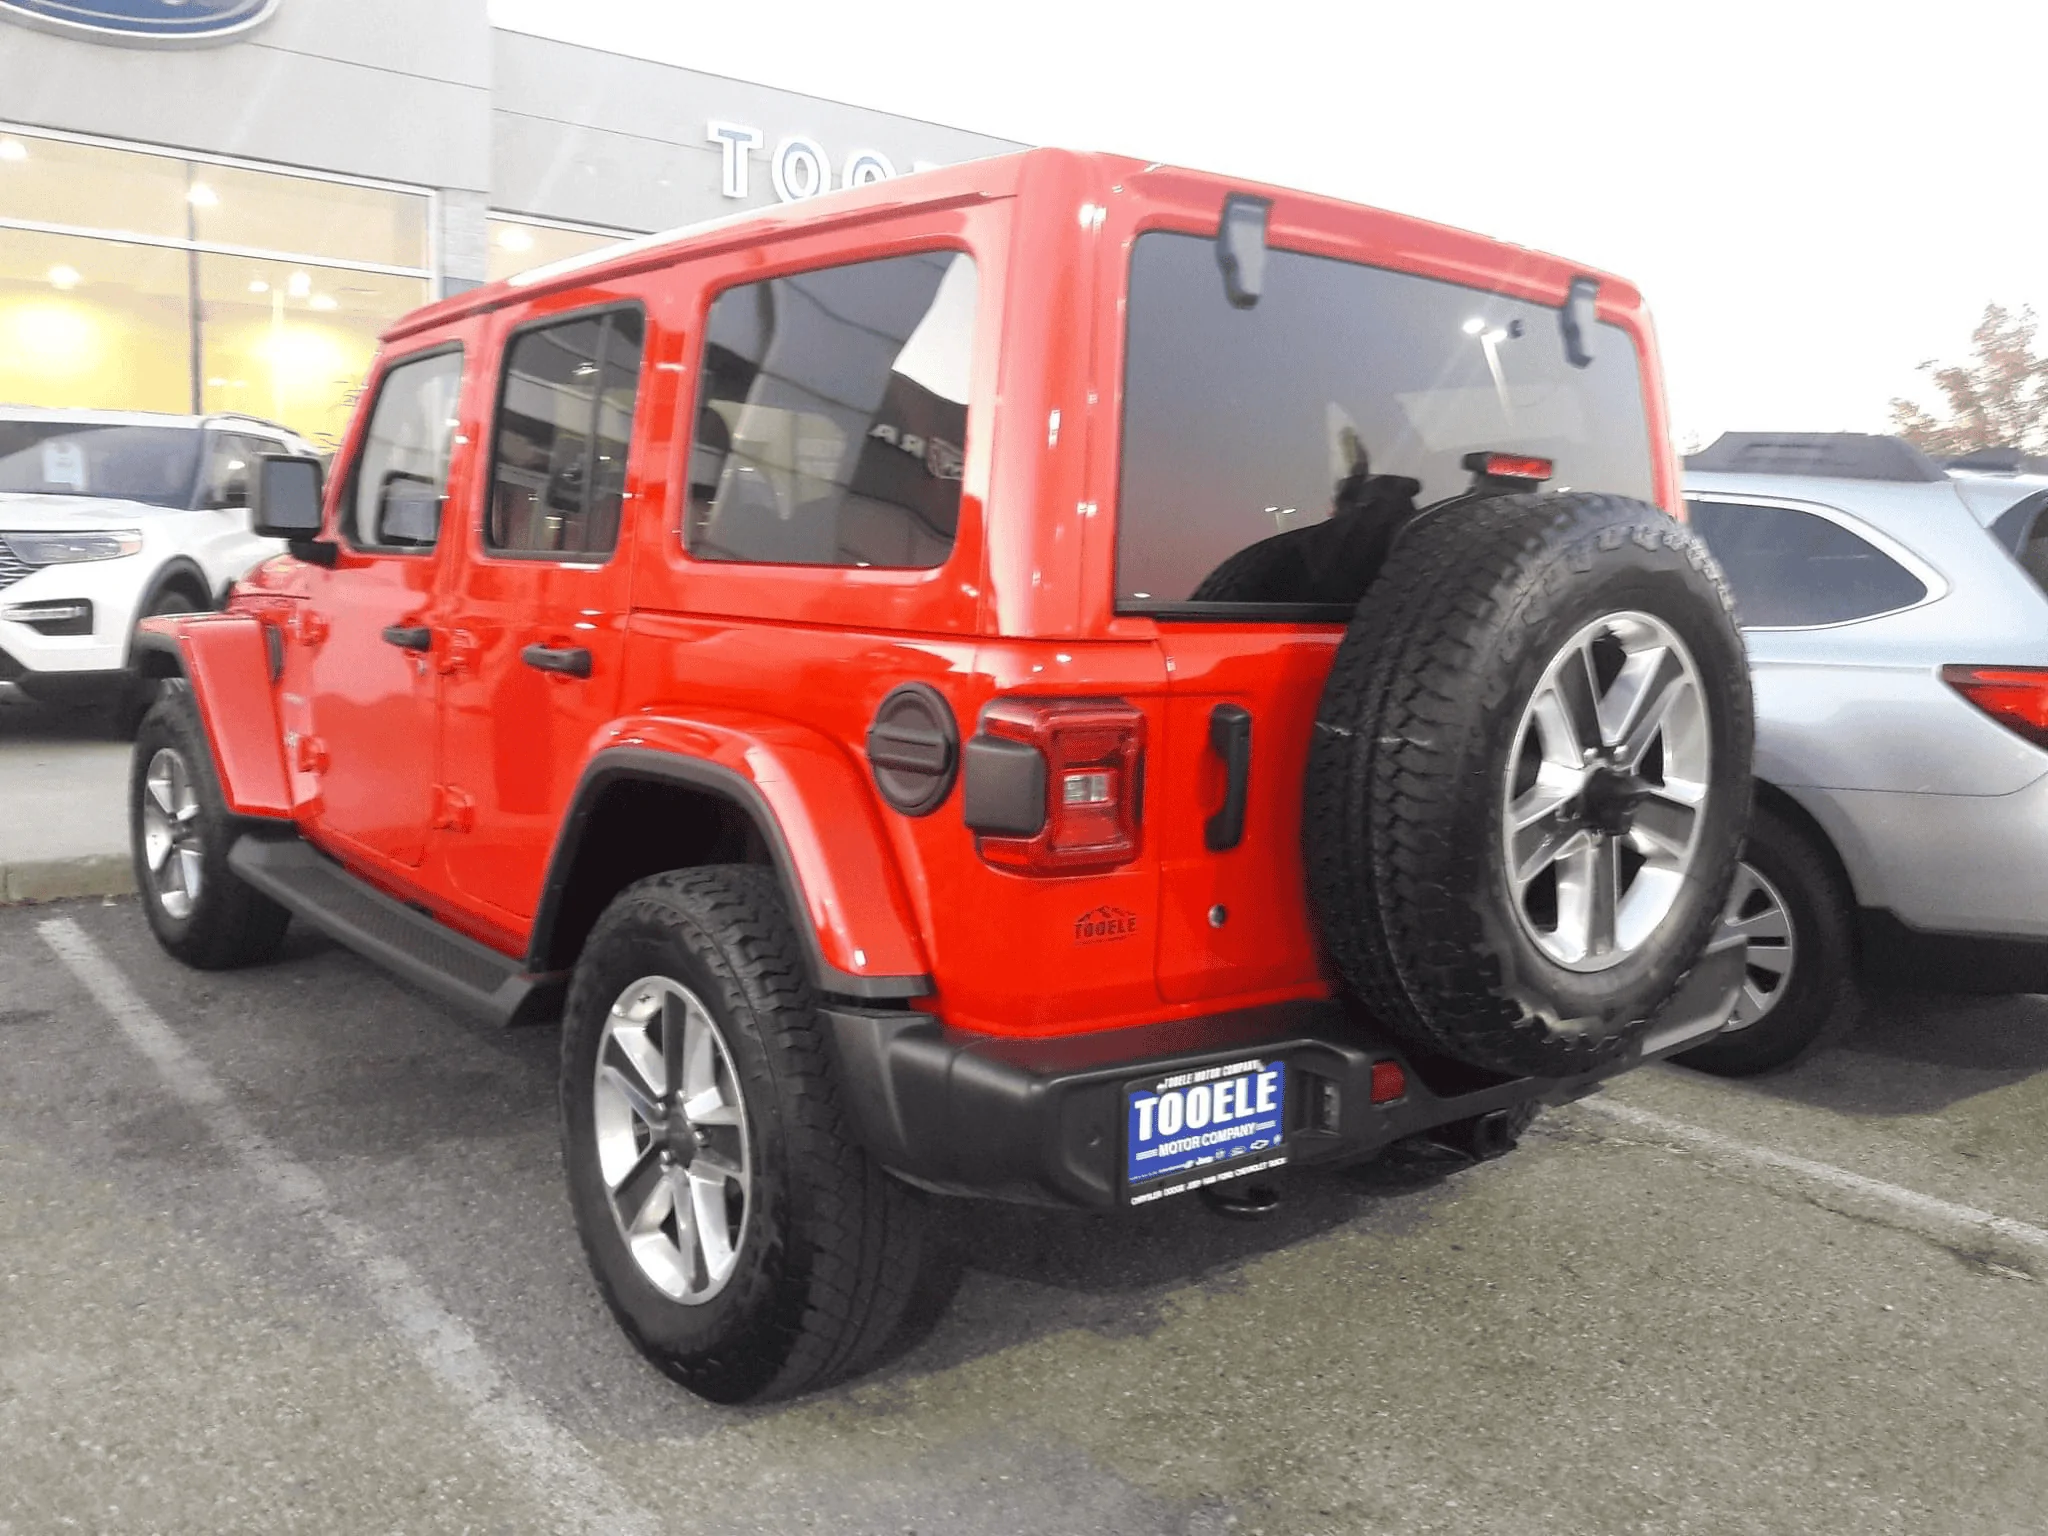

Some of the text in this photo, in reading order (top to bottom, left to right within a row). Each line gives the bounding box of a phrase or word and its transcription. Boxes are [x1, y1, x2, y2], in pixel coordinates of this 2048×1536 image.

[706, 120, 942, 204] TOO
[1074, 917, 1137, 940] TOOELE
[1164, 1072, 1193, 1088] TOOELE
[1194, 1067, 1221, 1083] MOTOR
[1134, 1071, 1278, 1141] TOOELE
[1158, 1122, 1257, 1157] MOTOR COMPANY
